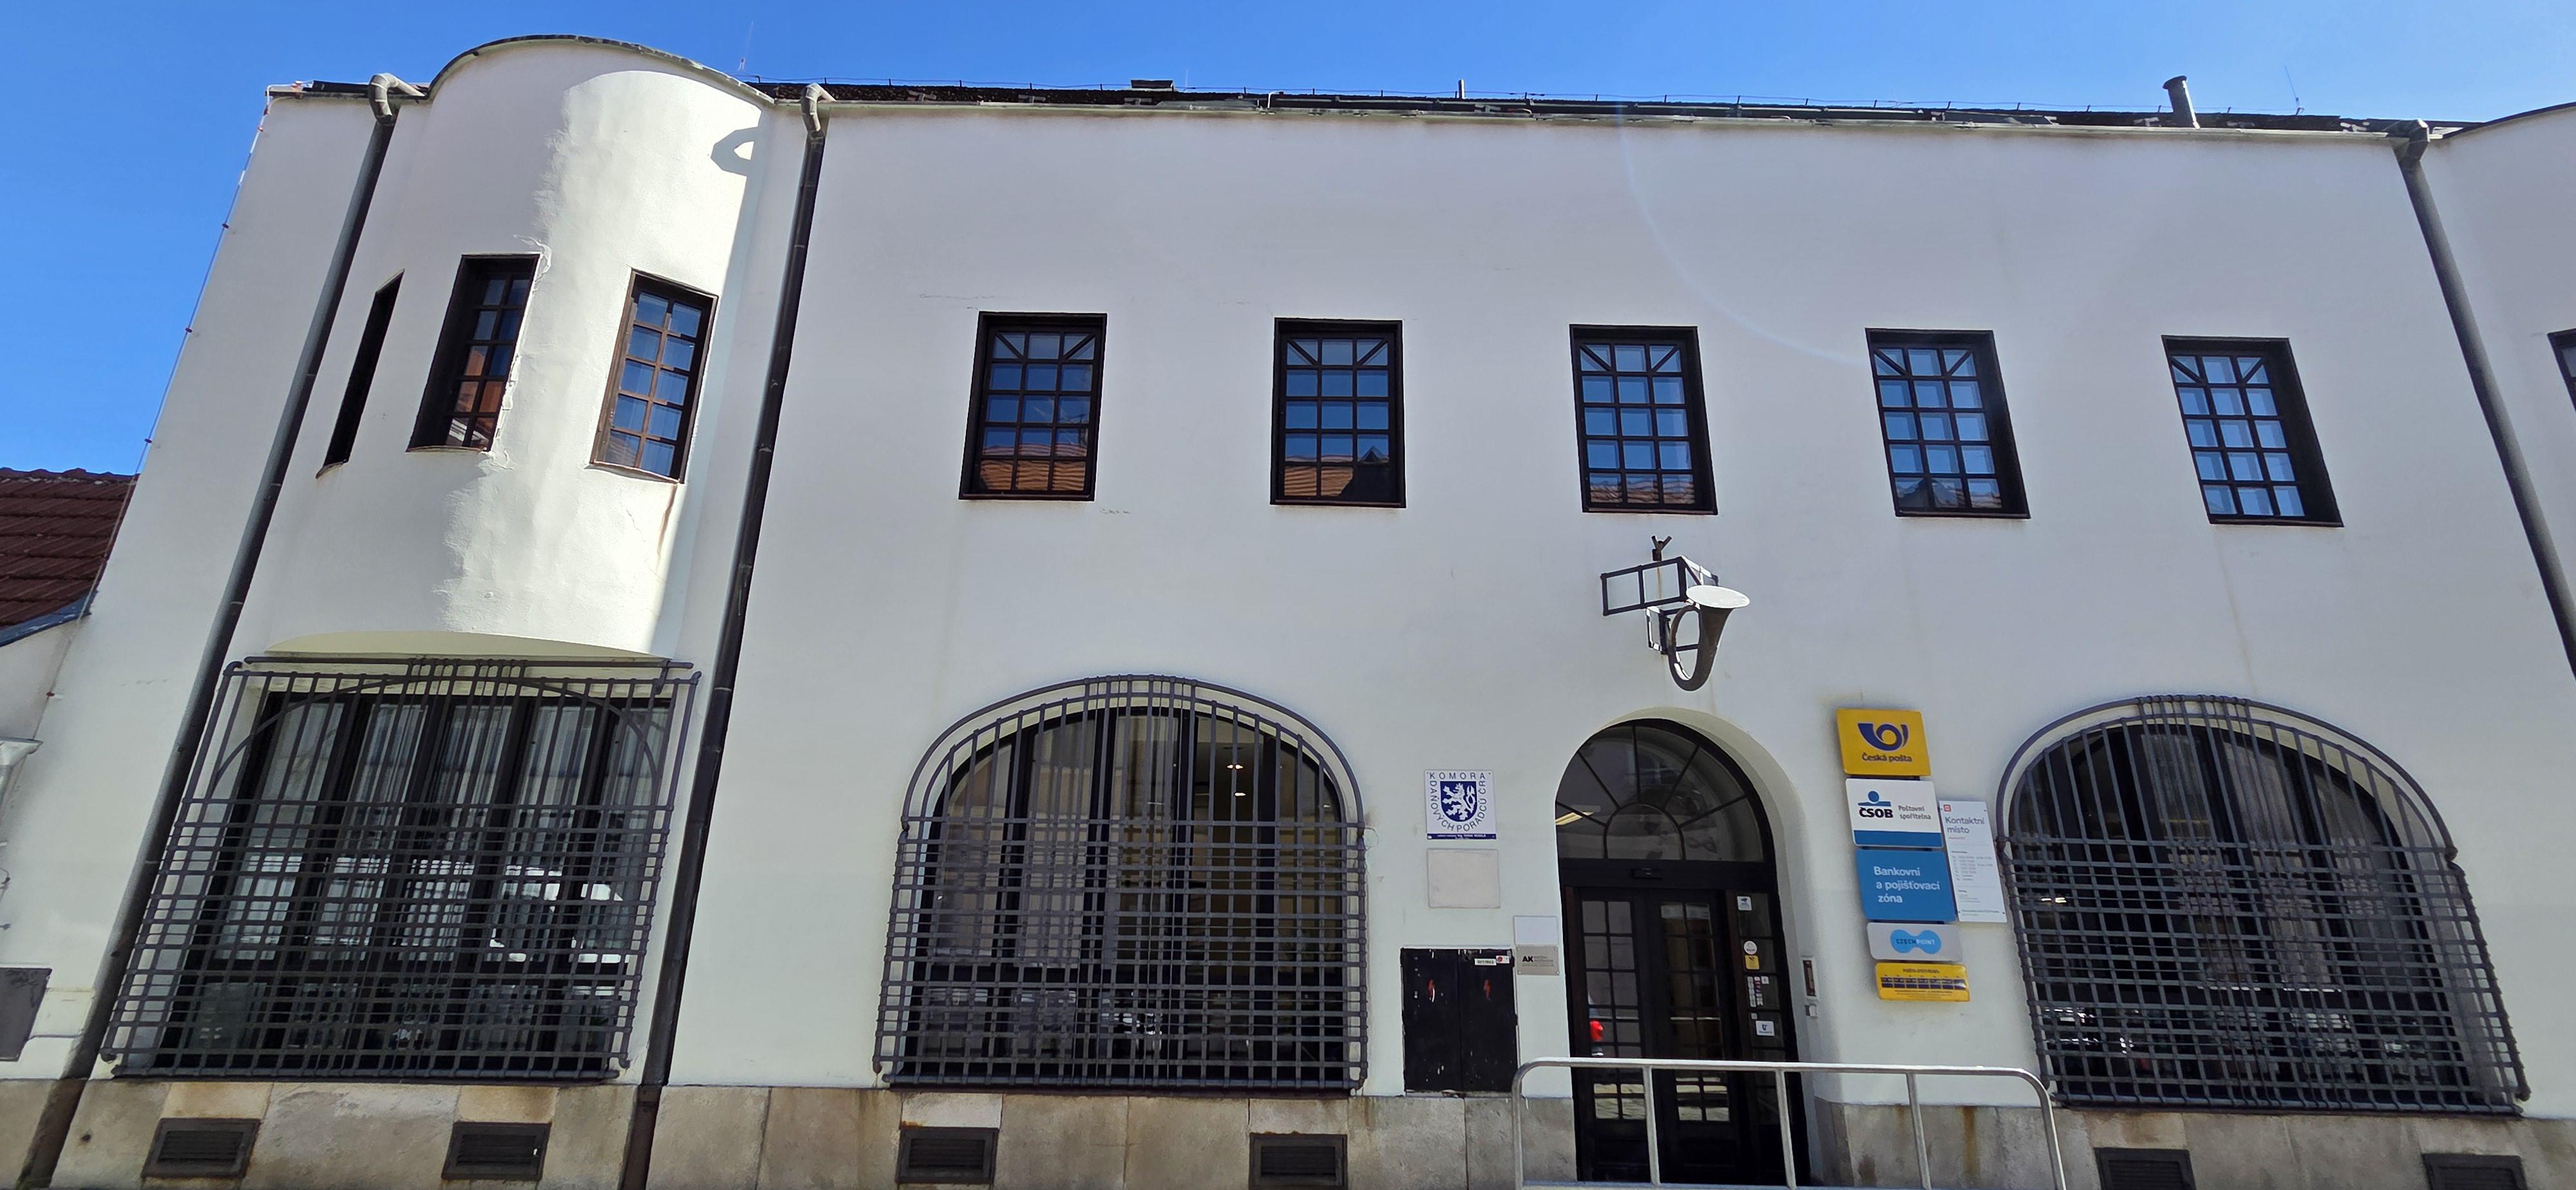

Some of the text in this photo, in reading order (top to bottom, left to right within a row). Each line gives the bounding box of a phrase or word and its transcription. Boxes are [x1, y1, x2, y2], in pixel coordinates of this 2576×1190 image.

[1862, 752, 1913, 763] Česká pošta
[1478, 780, 1486, 795] ČR
[1859, 807, 1894, 818] ČSOB
[1945, 817, 1985, 825] Kontaktní
[1947, 826, 1970, 834] místo
[1873, 866, 1921, 876] Bankovní
[1885, 880, 1940, 891] pojišťovací
[1877, 893, 1903, 903] zóna
